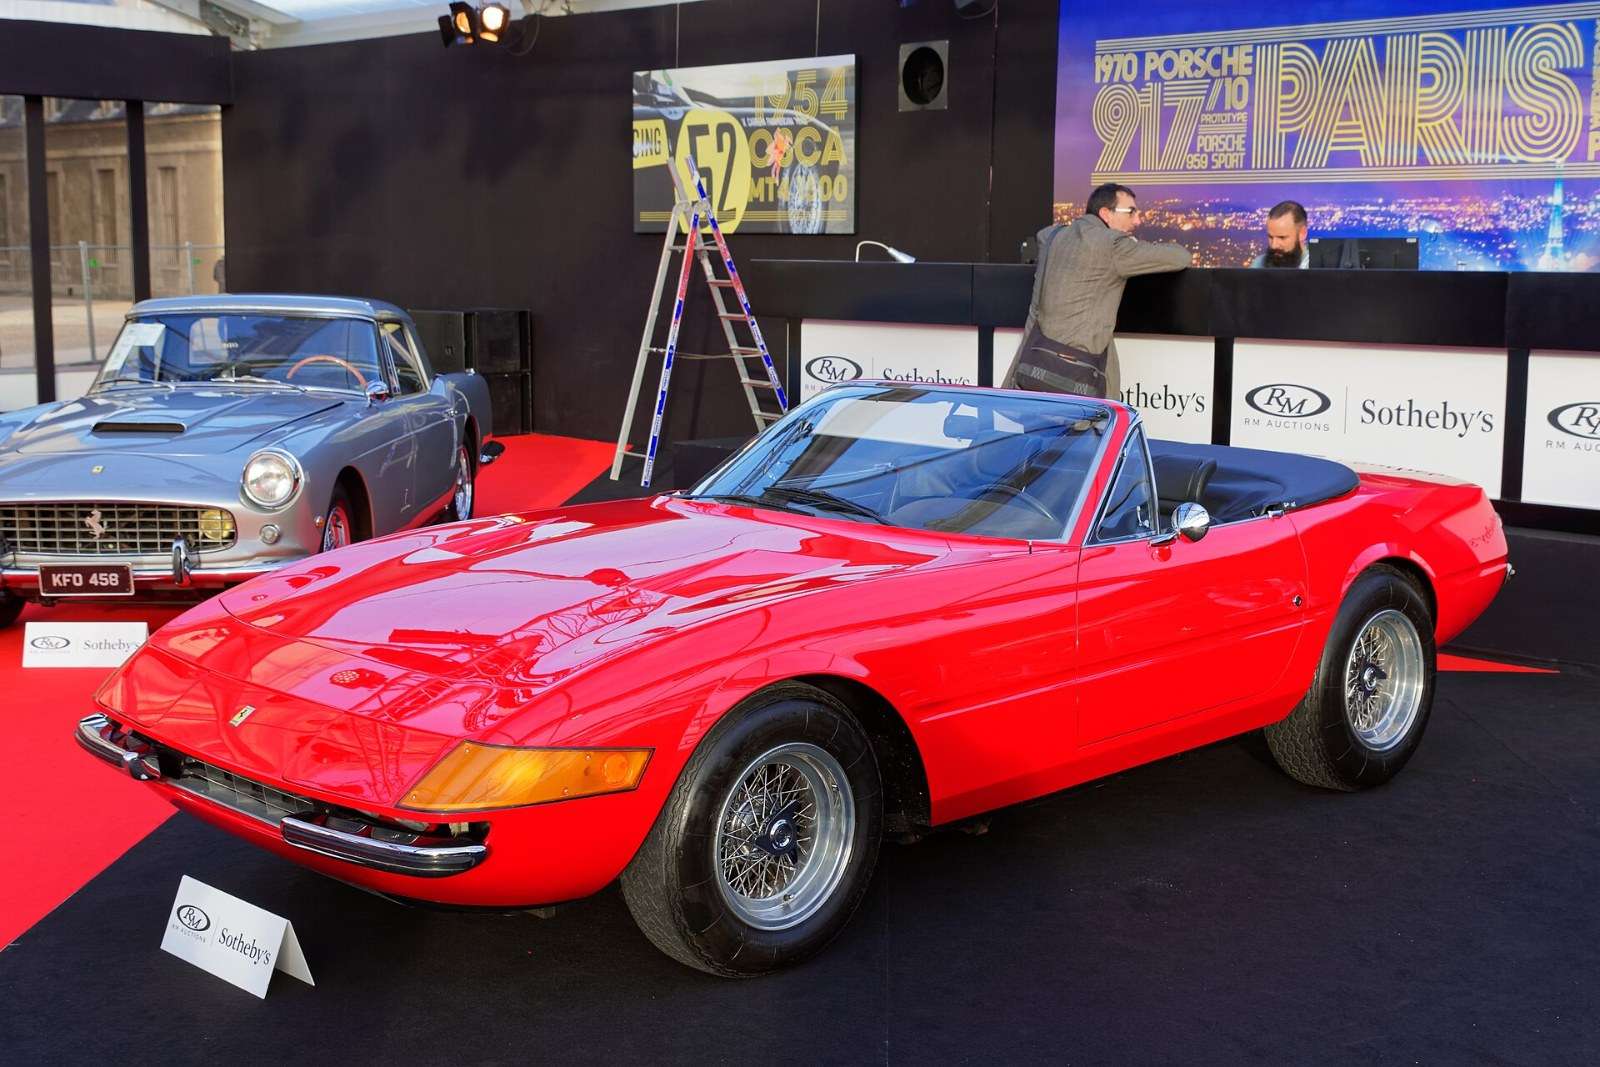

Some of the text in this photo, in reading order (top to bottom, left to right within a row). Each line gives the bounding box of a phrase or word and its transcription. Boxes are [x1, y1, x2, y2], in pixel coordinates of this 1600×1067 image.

[1094, 45, 1254, 83] 1970 PORSCHE
[753, 69, 848, 122] 1954
[1252, 21, 1585, 170] PARIS
[1200, 111, 1248, 124] PROTOTYPE
[1196, 133, 1247, 152] PORSCHE
[687, 122, 737, 229] 52
[1211, 152, 1246, 169] SPORT
[1120, 383, 1205, 417] theby's
[1264, 388, 1308, 414] RM
[1244, 418, 1331, 432] RM AUCTIONS
[1360, 399, 1494, 438] Sotheby's
[52, 573, 119, 587] KFO 458
[183, 908, 201, 929] RM
[218, 927, 271, 965] Sotheby's
